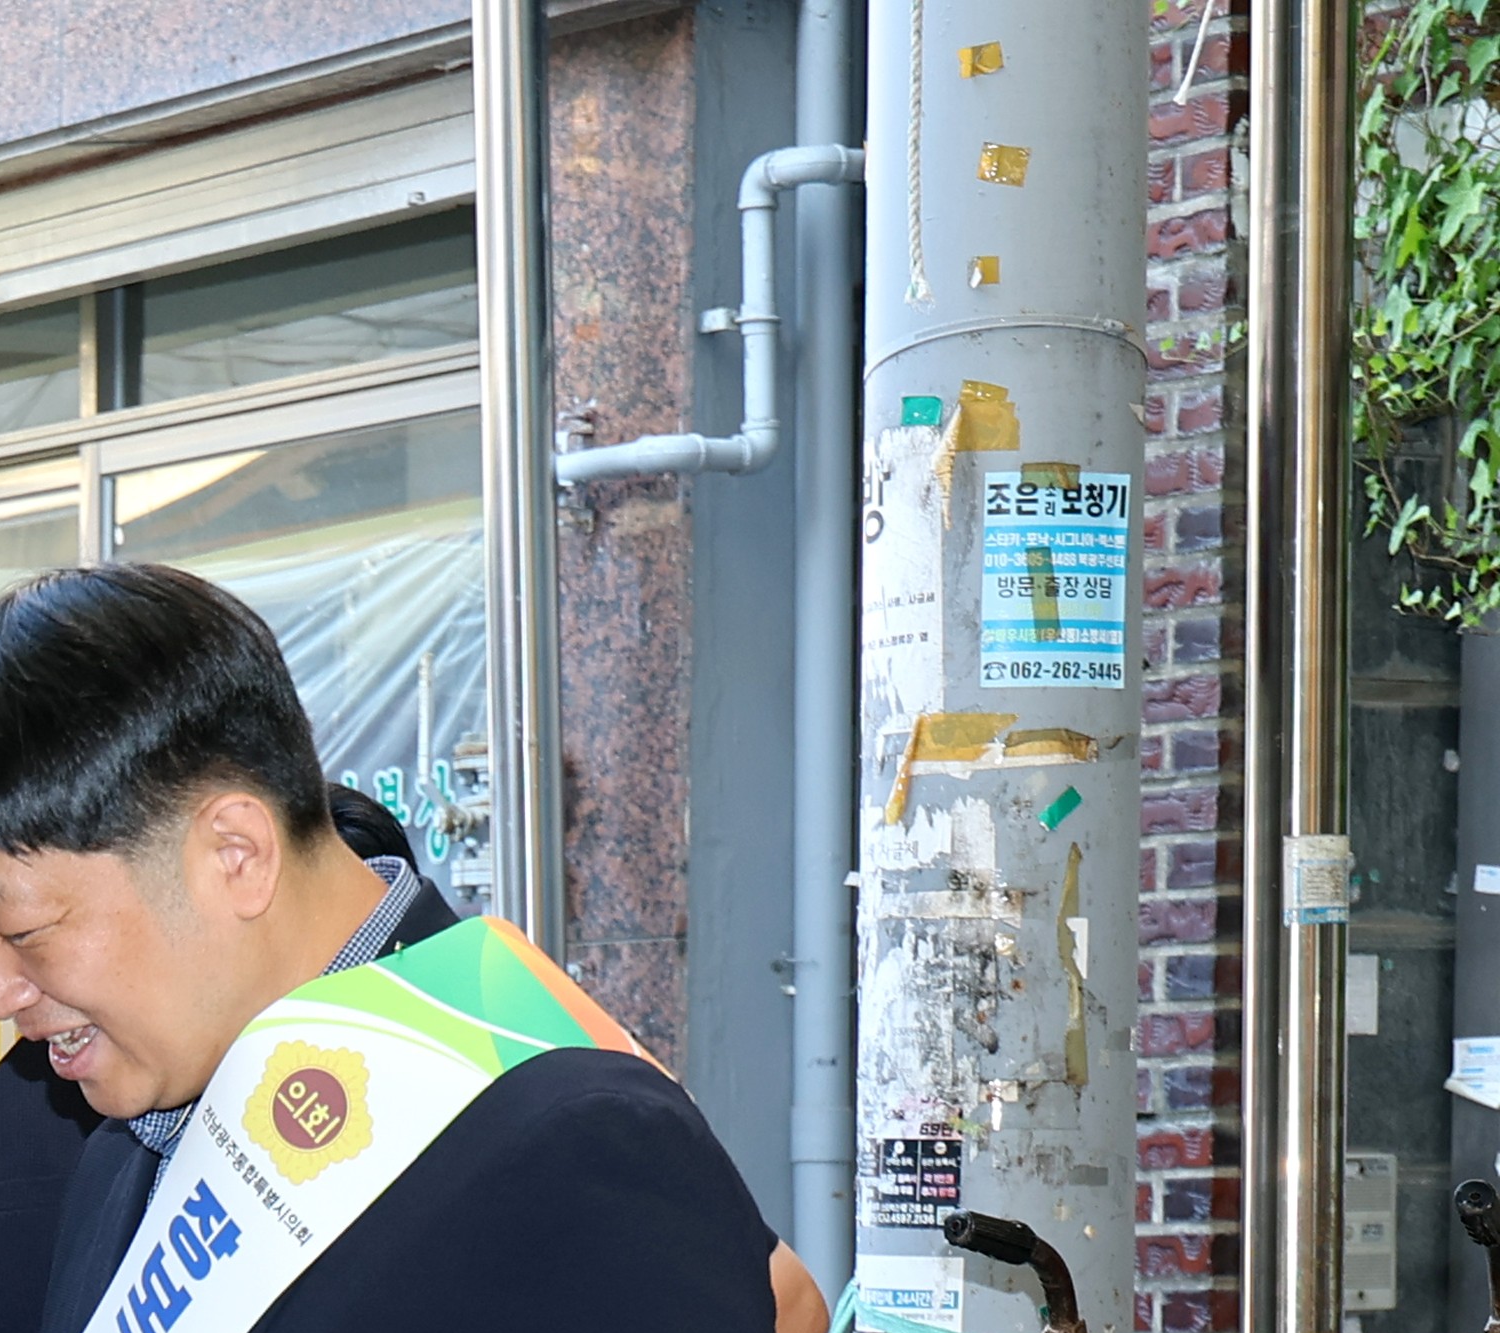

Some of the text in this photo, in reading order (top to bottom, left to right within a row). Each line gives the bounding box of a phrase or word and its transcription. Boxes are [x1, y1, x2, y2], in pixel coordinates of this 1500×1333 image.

[1060, 484, 1128, 519] 보청기
[1010, 661, 1122, 681] 062-262-5445
[276, 1079, 342, 1146] 의회
[200, 1102, 315, 1248] 전남광주통합특별시의회
